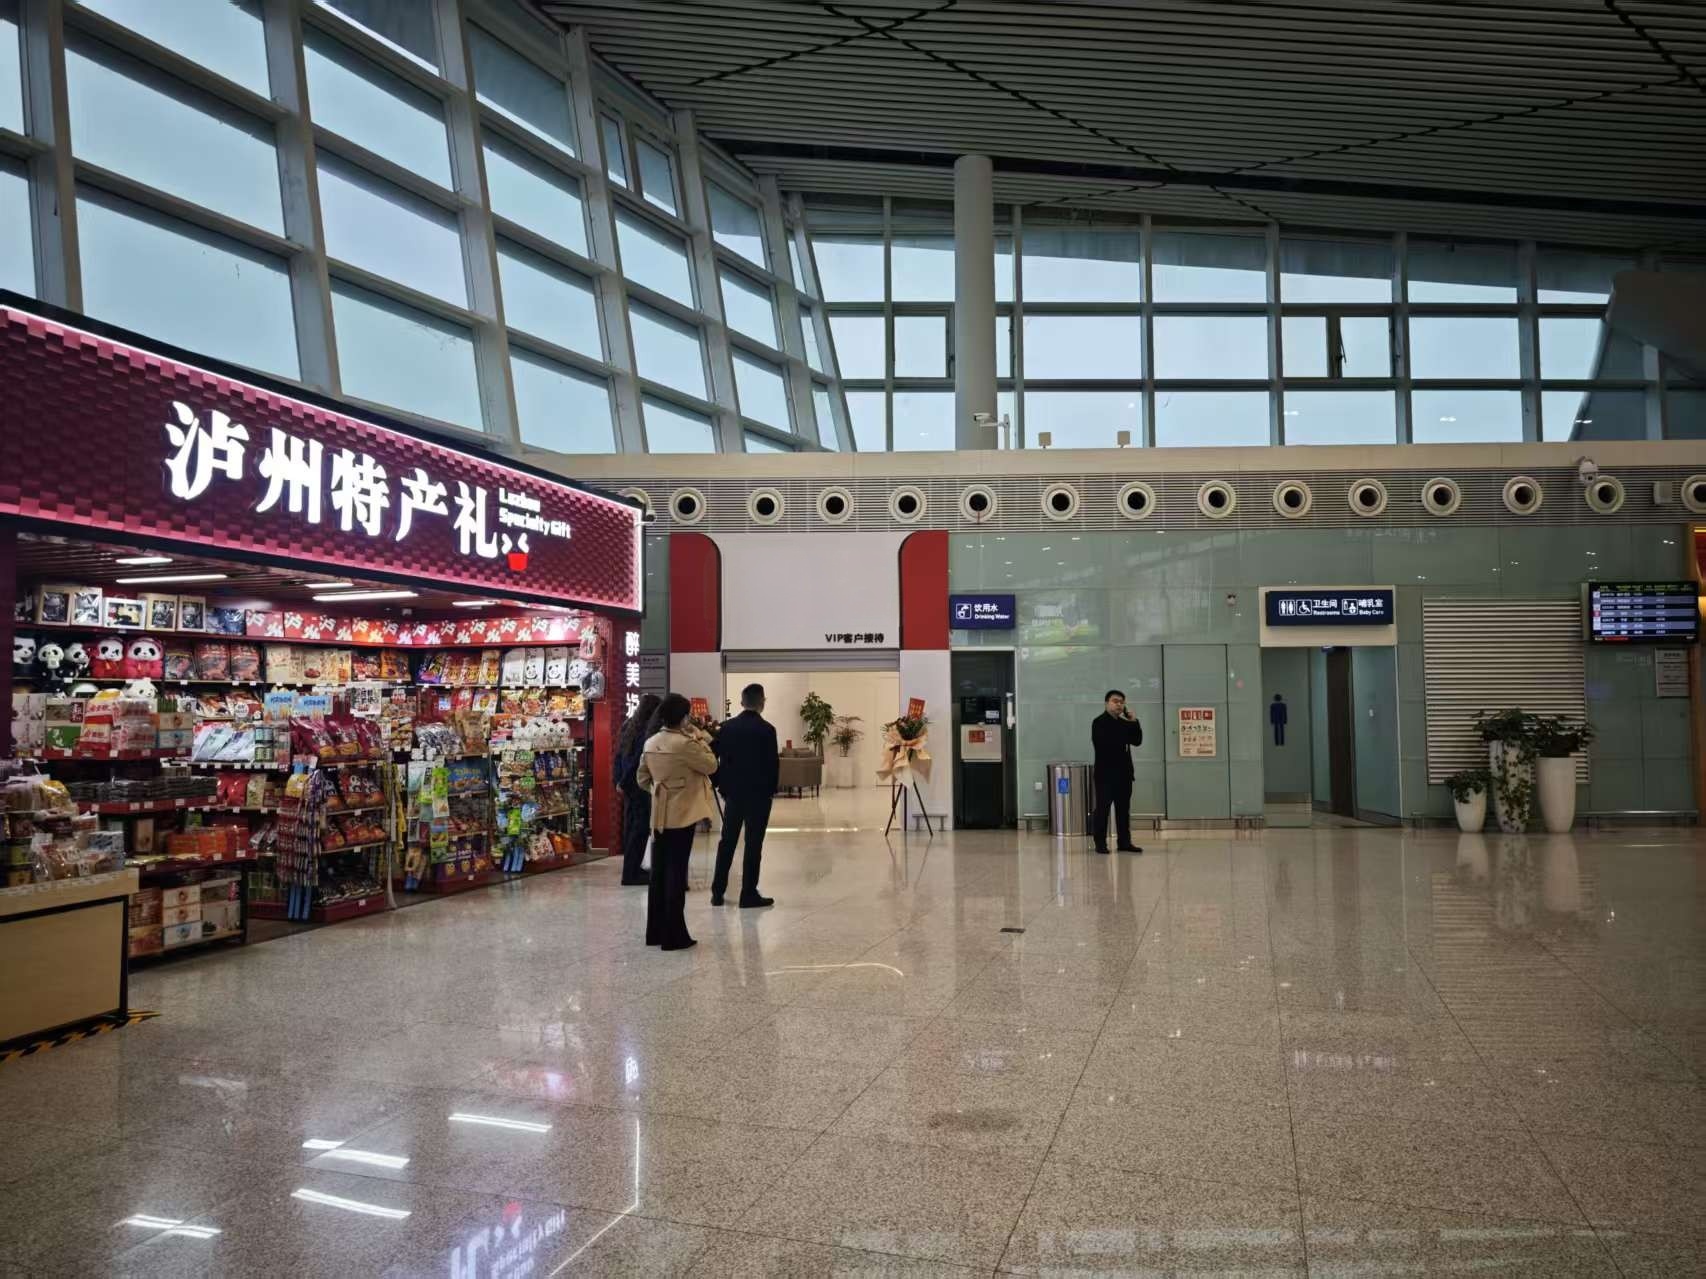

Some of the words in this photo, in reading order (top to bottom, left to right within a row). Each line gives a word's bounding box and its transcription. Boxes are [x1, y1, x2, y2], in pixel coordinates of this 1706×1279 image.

[164, 401, 498, 559] 泸州特产礼
[499, 507, 550, 536] Specialty
[550, 520, 571, 539] Gift
[974, 603, 999, 613] 饮用水
[1313, 599, 1338, 609] 卫生间
[974, 613, 995, 621] Drinking
[825, 633, 885, 644] VIP客户接待
